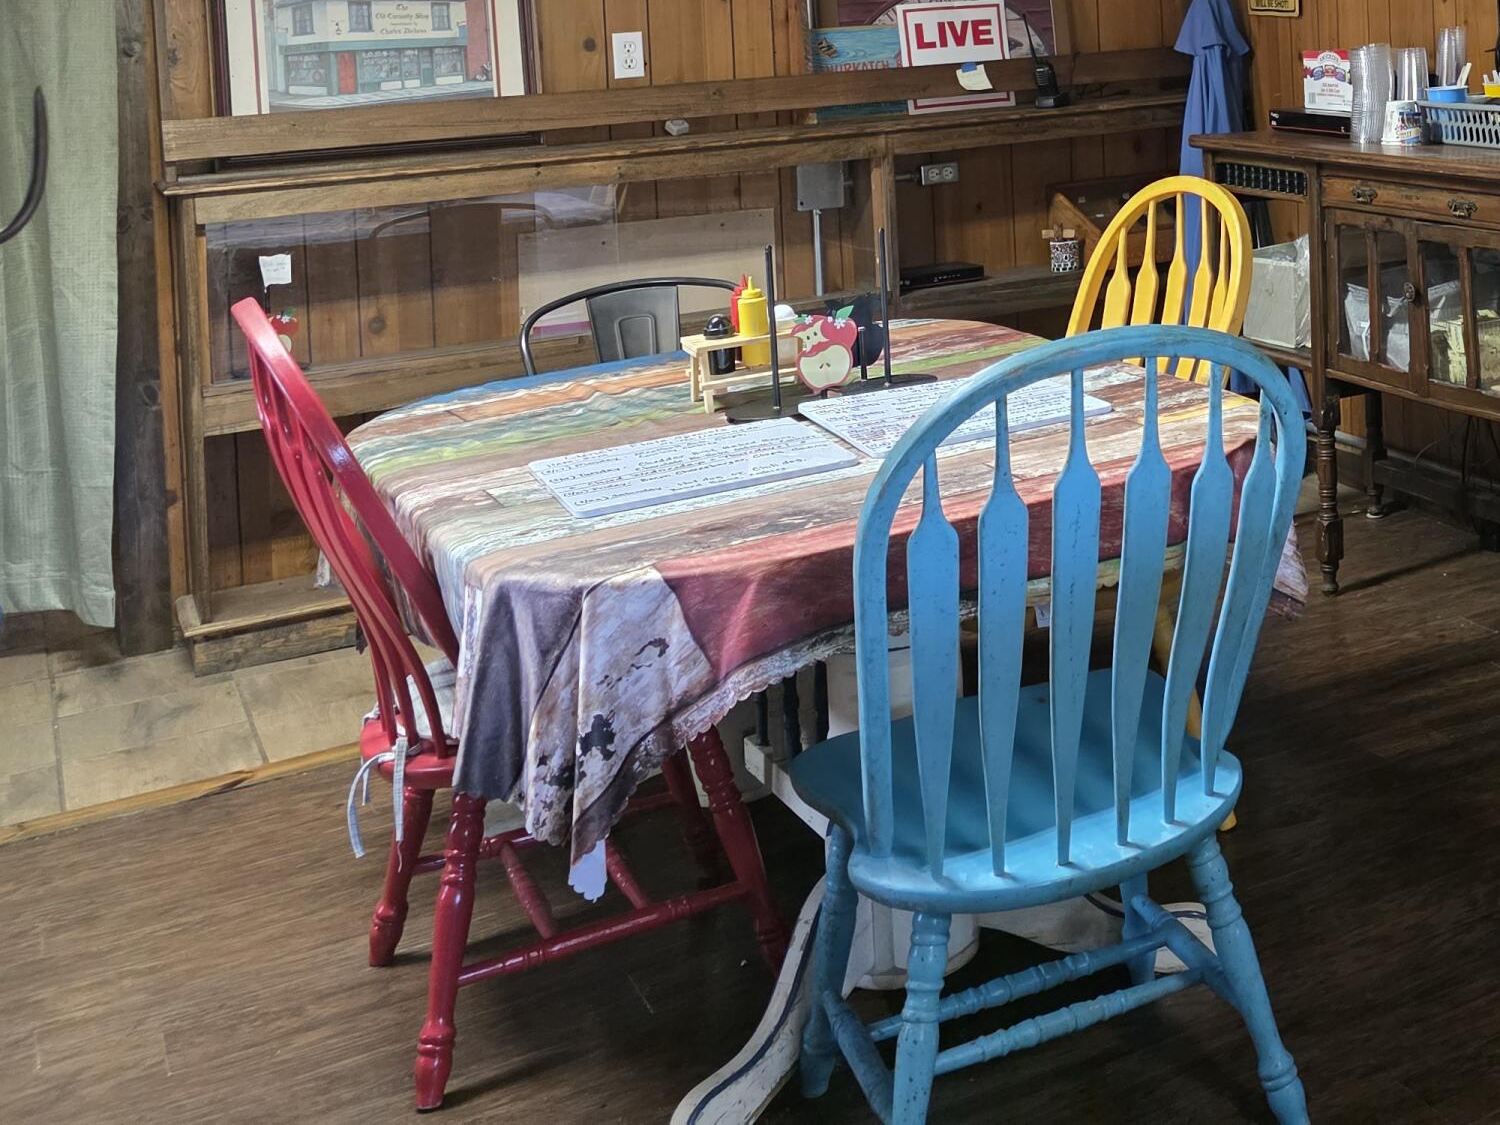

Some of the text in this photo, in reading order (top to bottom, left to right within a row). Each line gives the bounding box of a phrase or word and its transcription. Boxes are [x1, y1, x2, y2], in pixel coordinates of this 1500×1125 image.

[1256, 0, 1267, 8] WILL
[1268, 0, 1274, 8] BE
[914, 18, 995, 50] LIVE
